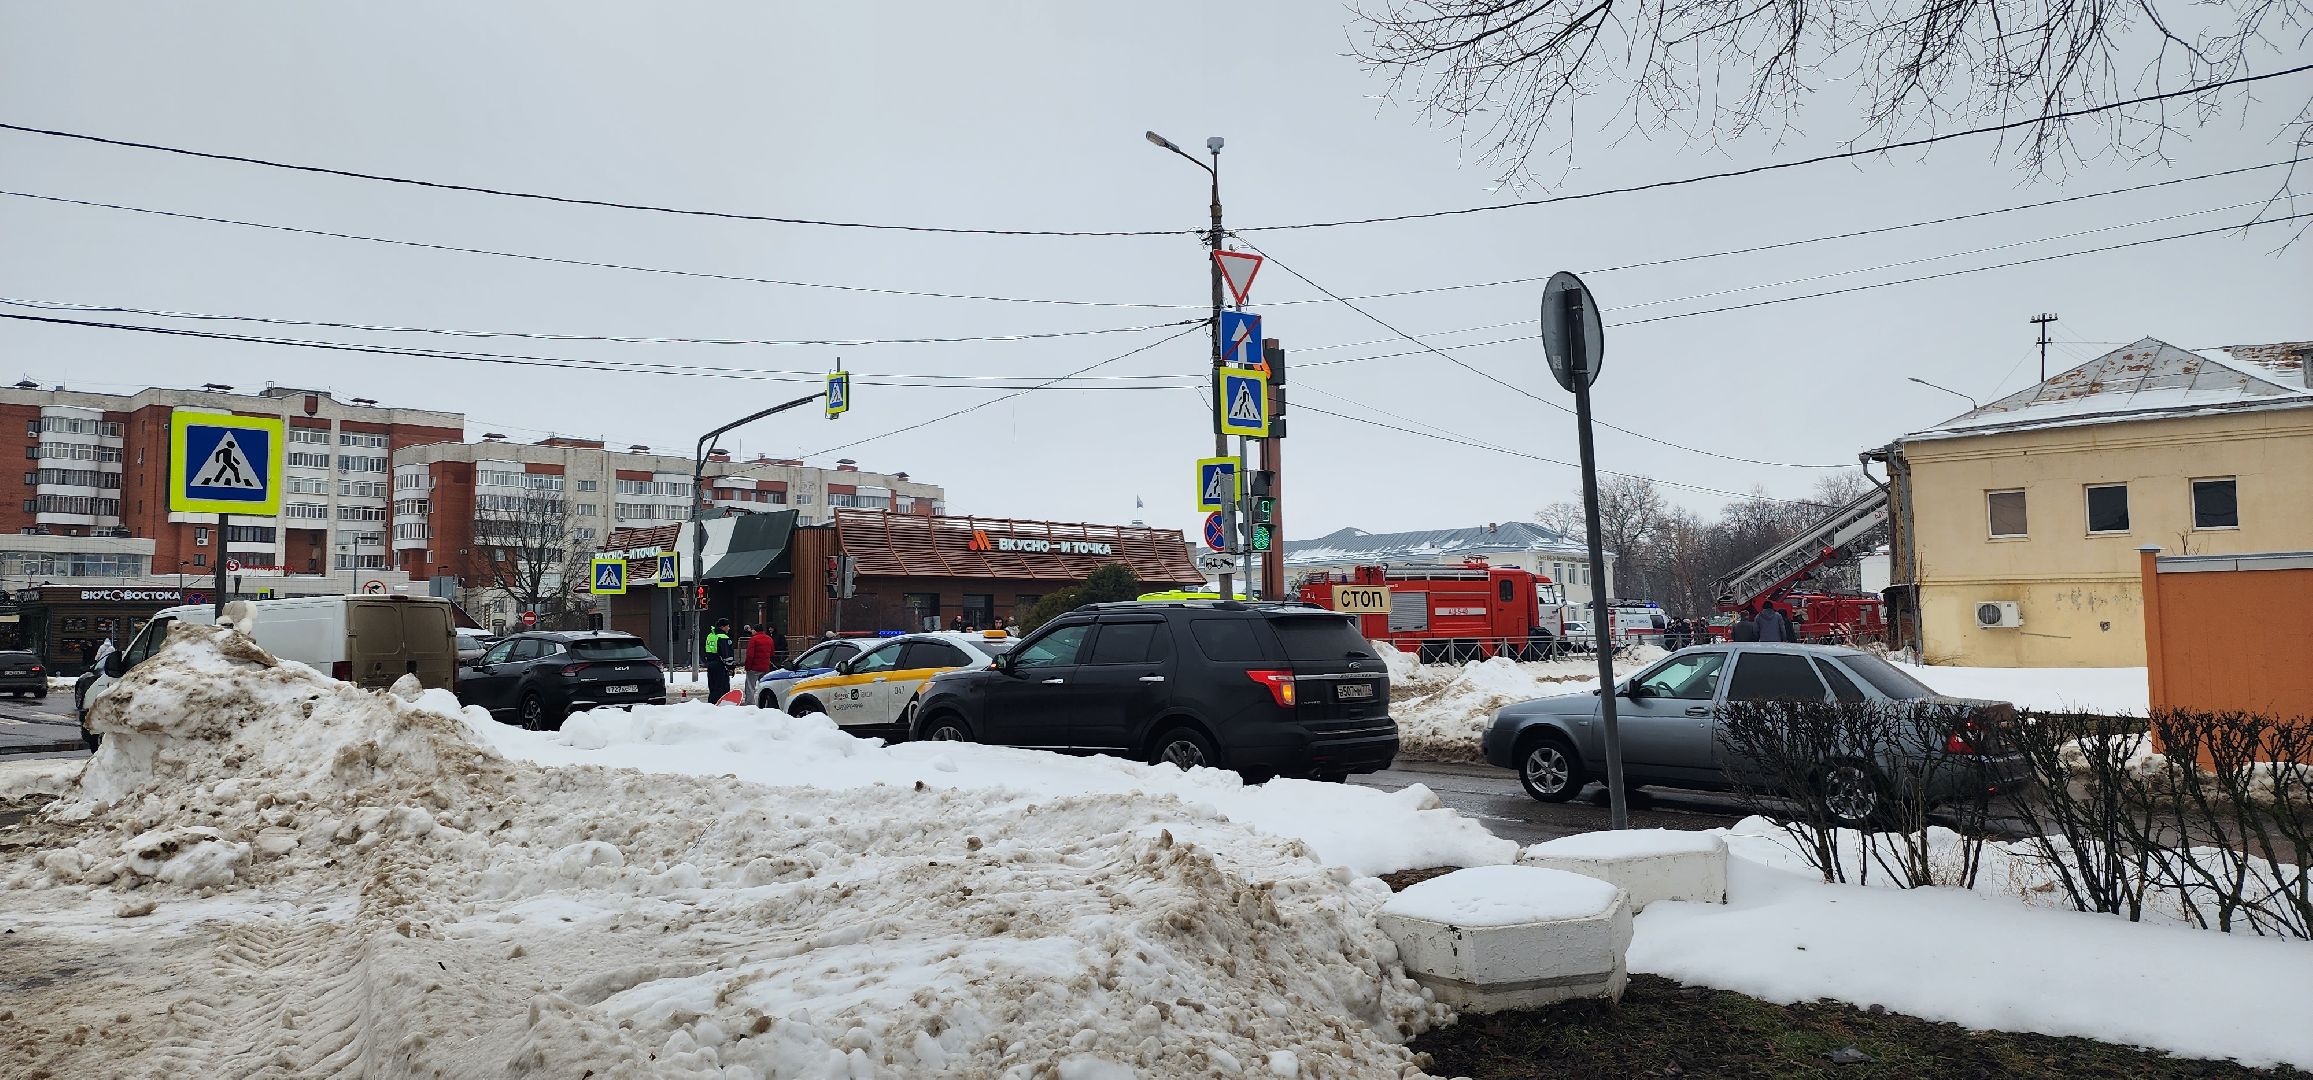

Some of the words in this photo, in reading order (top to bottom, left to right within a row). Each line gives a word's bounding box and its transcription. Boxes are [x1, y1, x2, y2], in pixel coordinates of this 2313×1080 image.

[1261, 500, 1270, 522] 9
[1074, 541, 1112, 554] ТОЧКА
[123, 590, 180, 600] ВОСТОКА
[1341, 590, 1383, 607] СТОП
